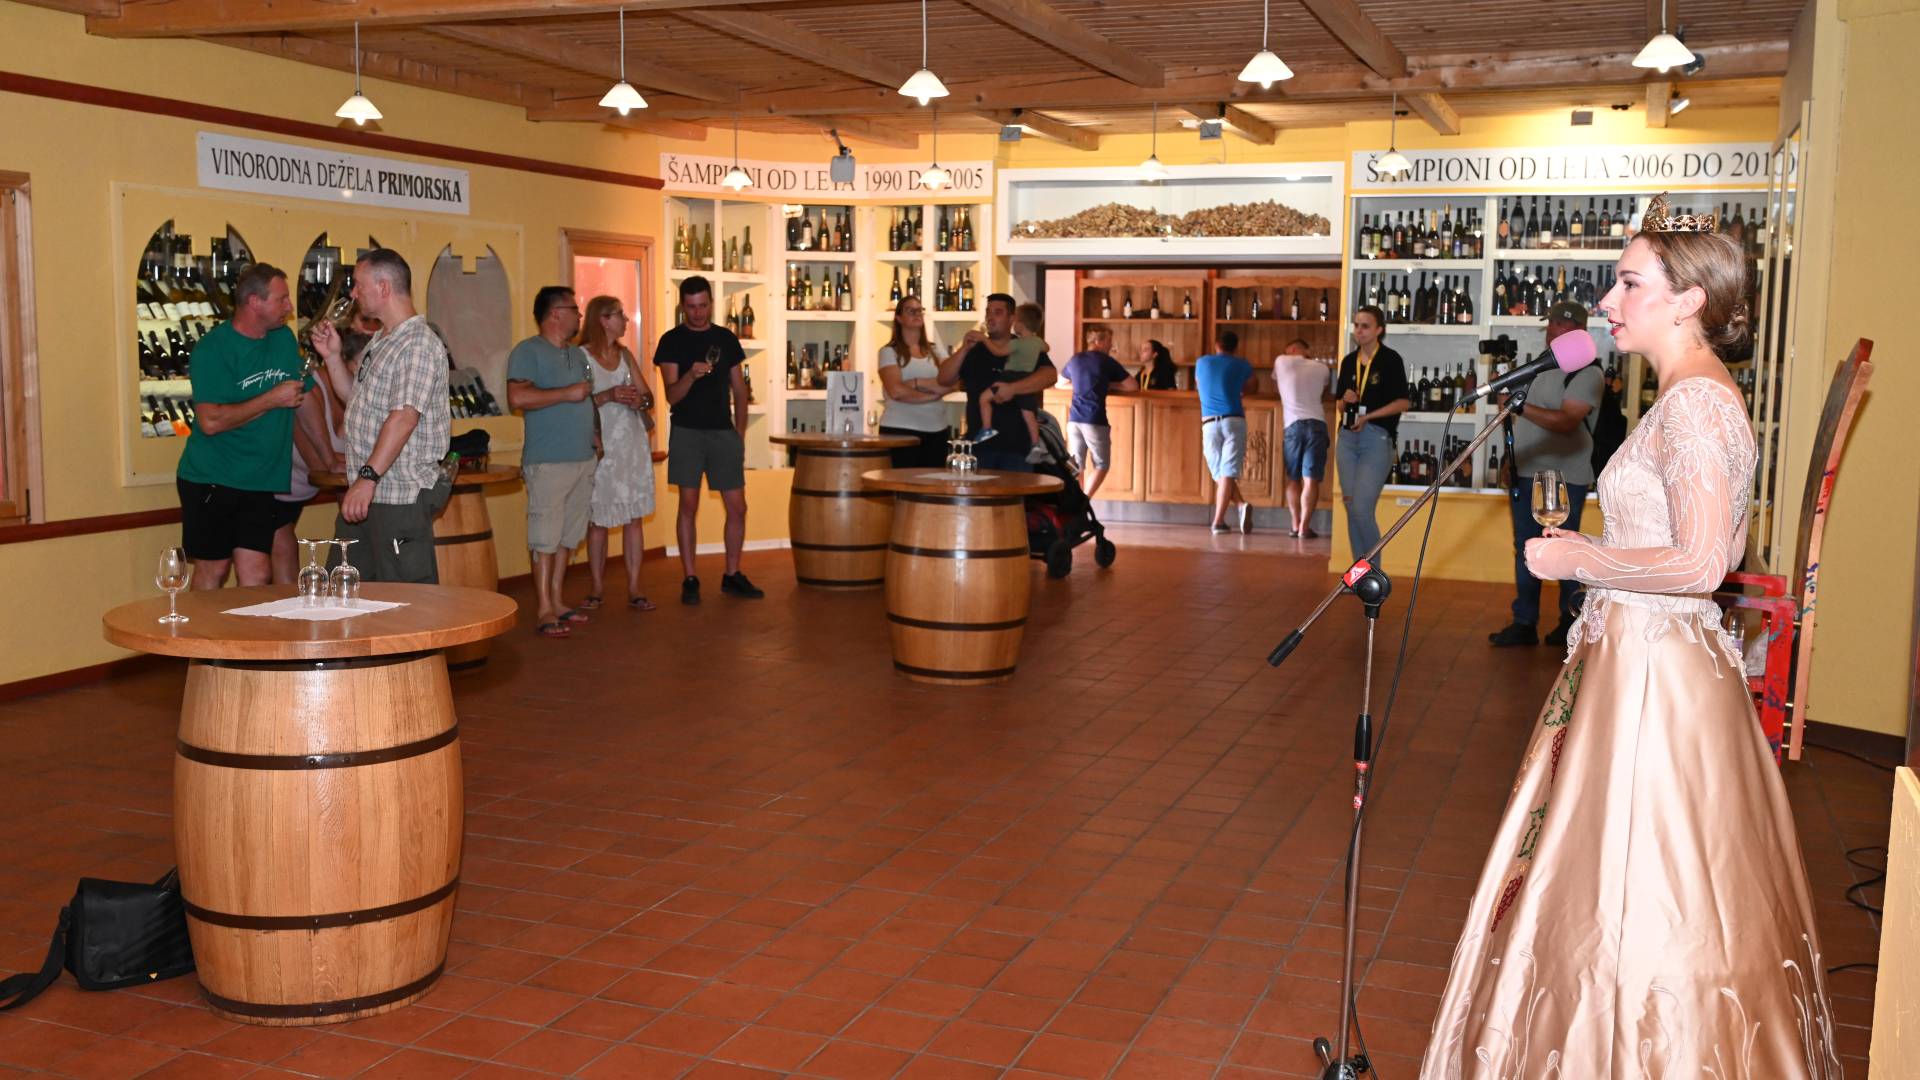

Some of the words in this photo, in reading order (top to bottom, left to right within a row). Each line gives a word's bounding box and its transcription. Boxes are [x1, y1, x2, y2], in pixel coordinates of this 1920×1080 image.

[211, 147, 312, 185] VINORODNA
[317, 159, 374, 193] DEŽELA
[378, 170, 462, 203] PRIMORSKA
[767, 168, 797, 191] OD
[864, 170, 903, 192] 1990
[908, 170, 935, 191] D
[1499, 156, 1537, 180] OD
[1618, 153, 1674, 179] 2006
[1682, 152, 1723, 178] DO
